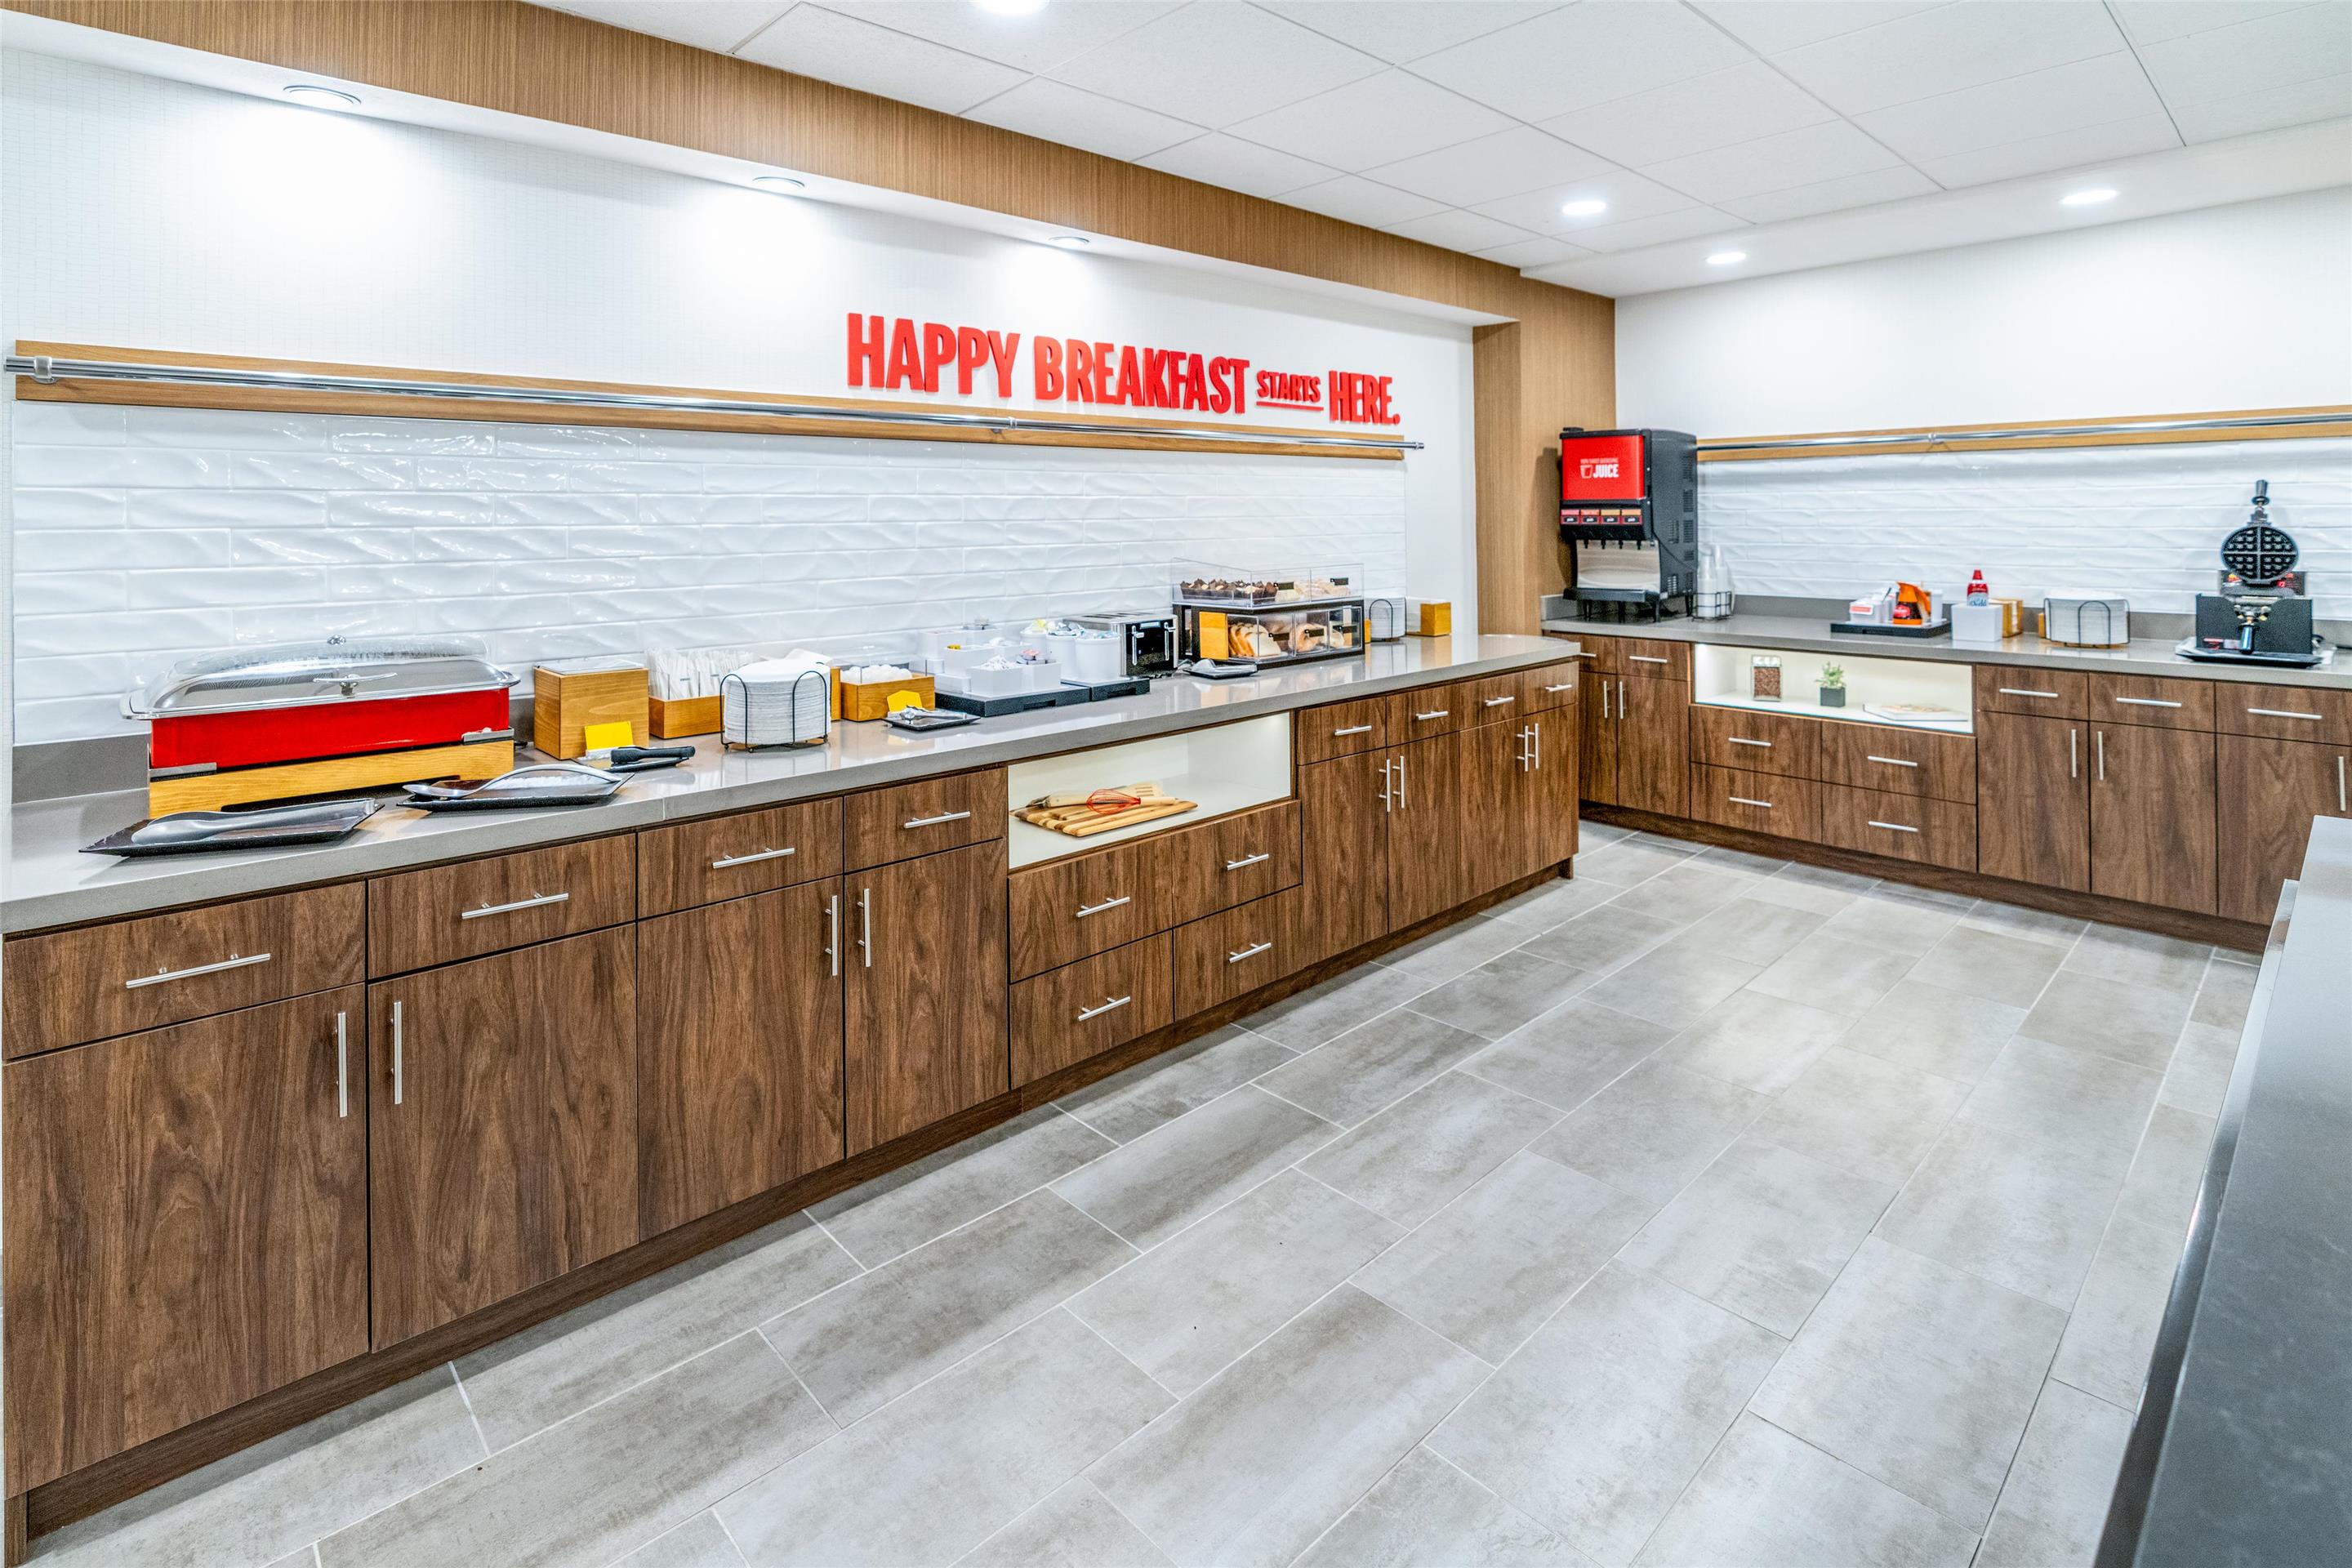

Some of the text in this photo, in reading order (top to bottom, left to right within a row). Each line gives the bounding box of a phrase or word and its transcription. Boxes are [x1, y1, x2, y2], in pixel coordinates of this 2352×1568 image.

[847, 313, 1401, 425] HAPPY BREAKFAST STARTS HERE.
[1592, 464, 1619, 478] JUICE
